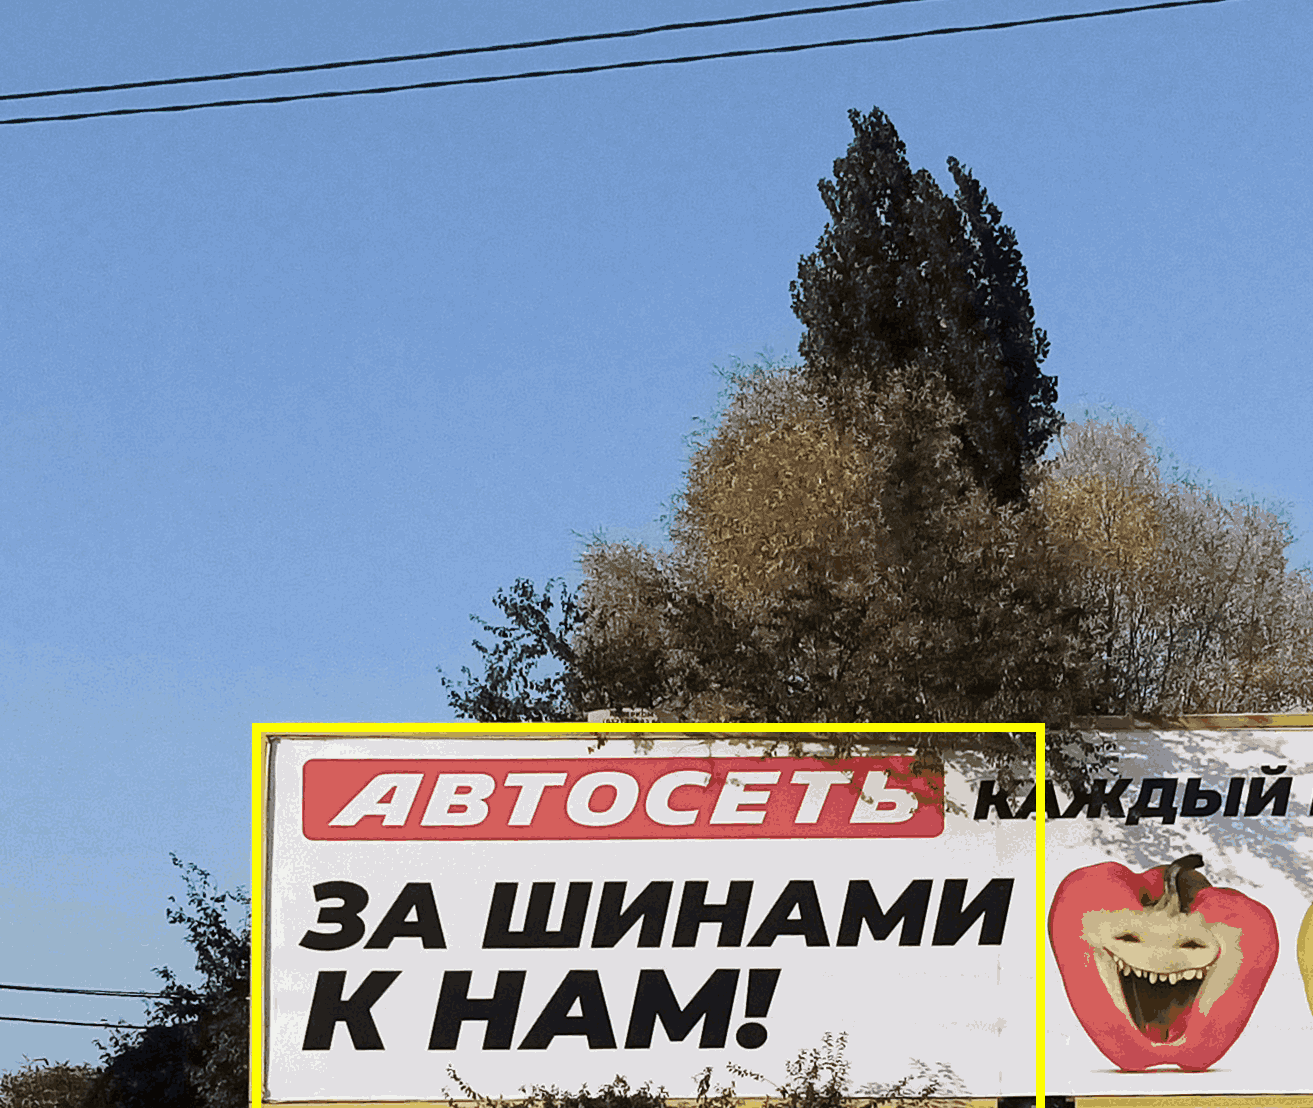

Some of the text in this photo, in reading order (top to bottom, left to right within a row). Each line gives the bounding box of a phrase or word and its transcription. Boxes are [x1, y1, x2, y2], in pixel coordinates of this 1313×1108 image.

[327, 770, 919, 827] АВТОСЕТЬ
[973, 764, 1294, 826] КАЖДЫЙ
[299, 877, 1015, 952] ЗА ШИНАМИ
[301, 968, 783, 1052] К НАМ!
